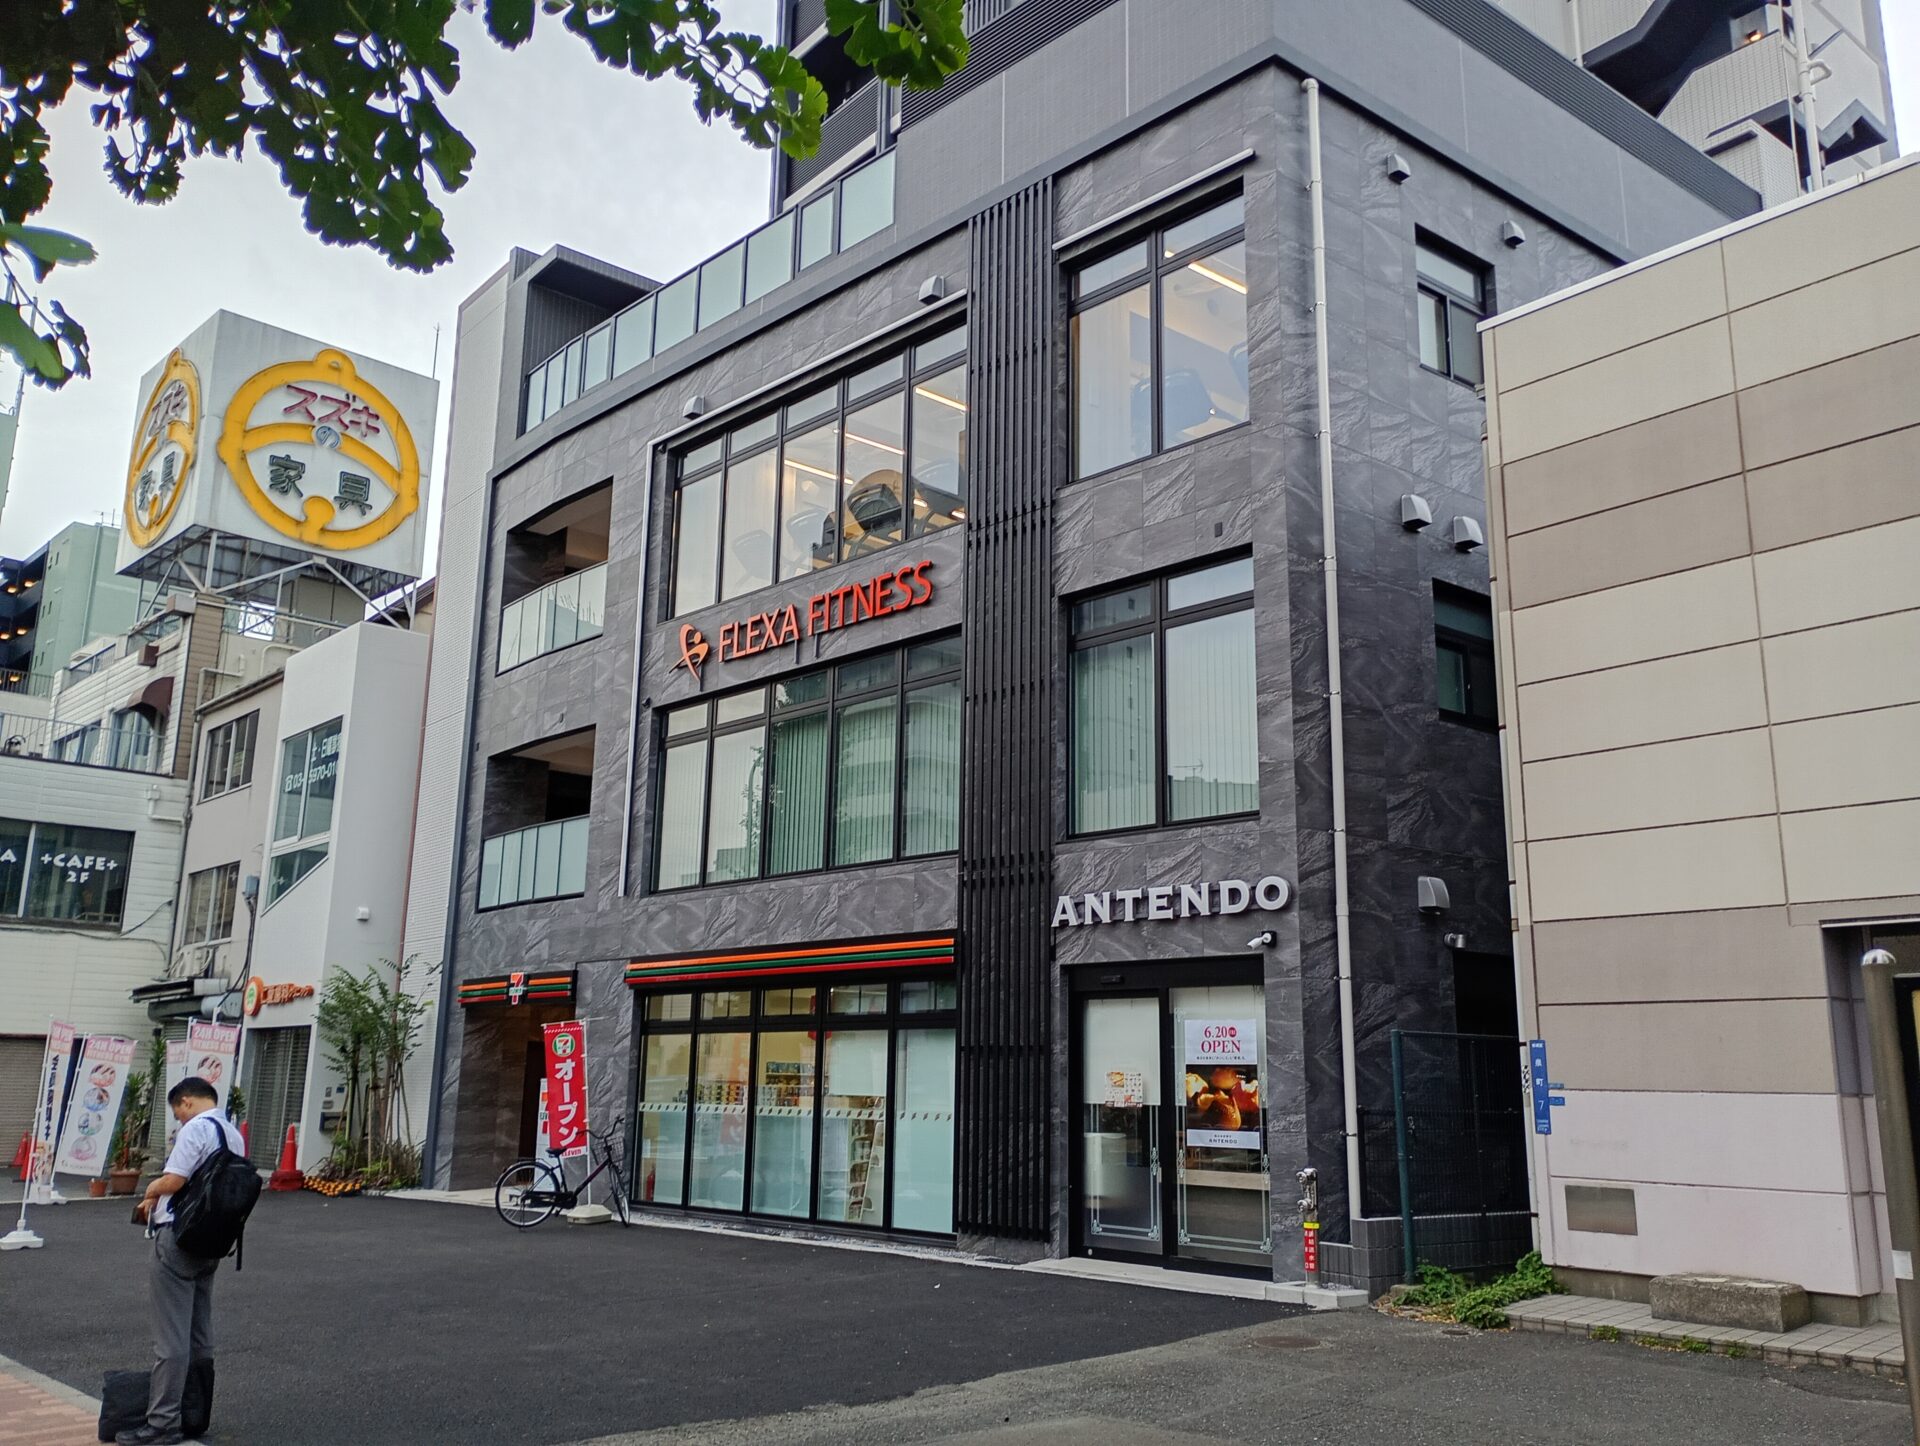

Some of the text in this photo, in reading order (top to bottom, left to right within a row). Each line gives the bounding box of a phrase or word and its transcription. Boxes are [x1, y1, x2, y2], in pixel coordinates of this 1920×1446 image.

[283, 384, 380, 438] スズキ
[315, 426, 341, 450] の
[269, 454, 373, 516] 家具
[718, 560, 933, 663] FLEXA FITNESS
[66, 871, 90, 883] 2F
[1051, 875, 1290, 928] ANTENDO
[214, 1028, 237, 1041] OPEN
[1204, 1026, 1228, 1039] 6.20
[108, 1041, 132, 1055] OPEN
[1201, 1040, 1241, 1053] OPEN
[555, 1058, 579, 1147] オープン
